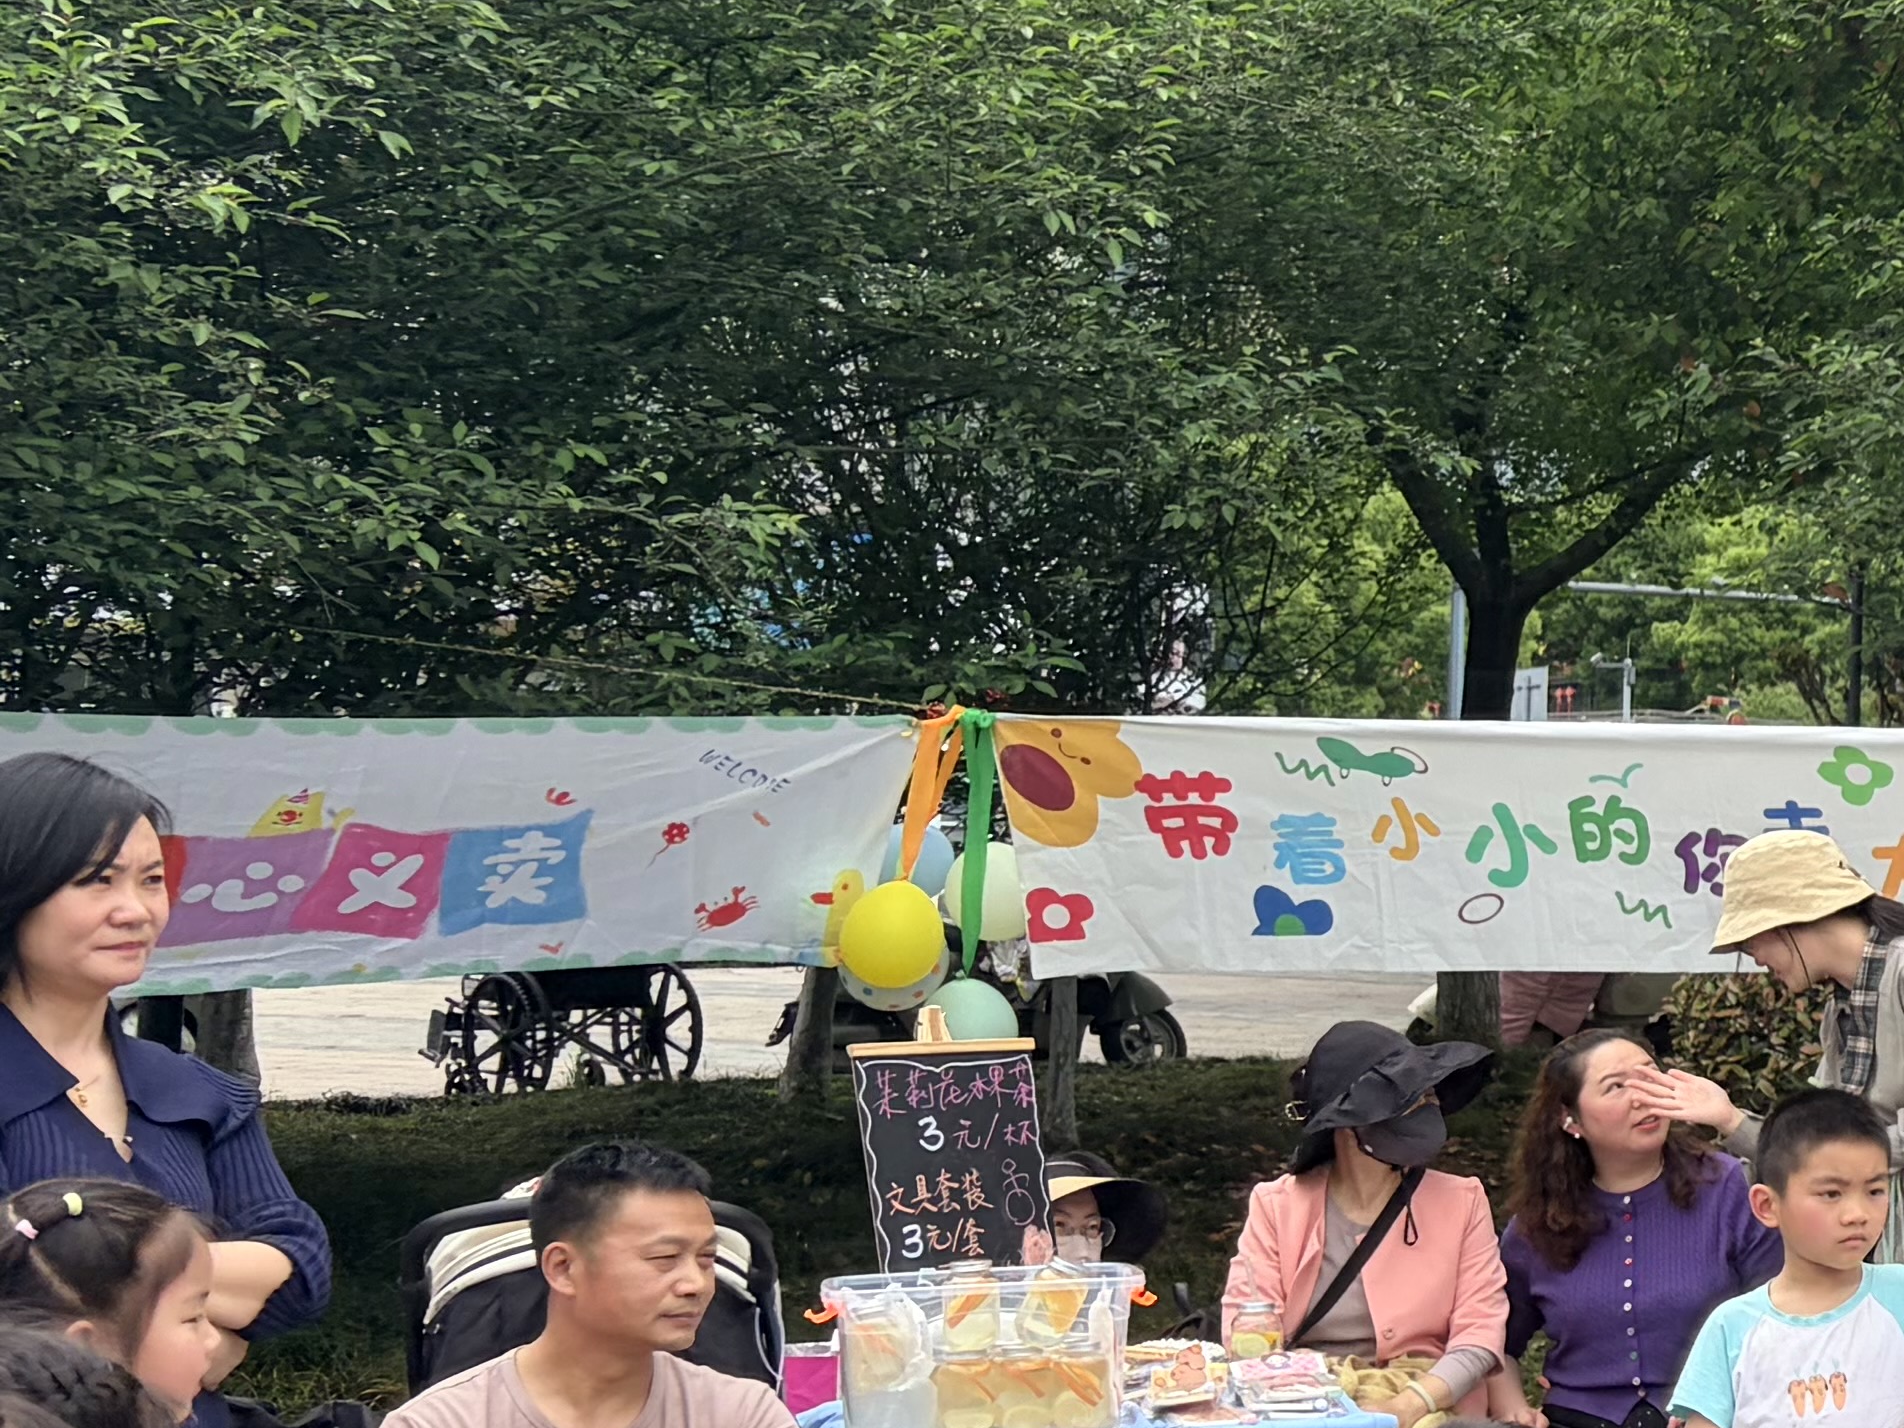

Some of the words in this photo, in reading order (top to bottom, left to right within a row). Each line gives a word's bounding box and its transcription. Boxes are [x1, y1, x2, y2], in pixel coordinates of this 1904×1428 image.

[872, 1061, 1035, 1119] 茉莉花水果茶
[885, 1168, 993, 1215] 文具套装
[902, 1218, 985, 1258] 3元/套
